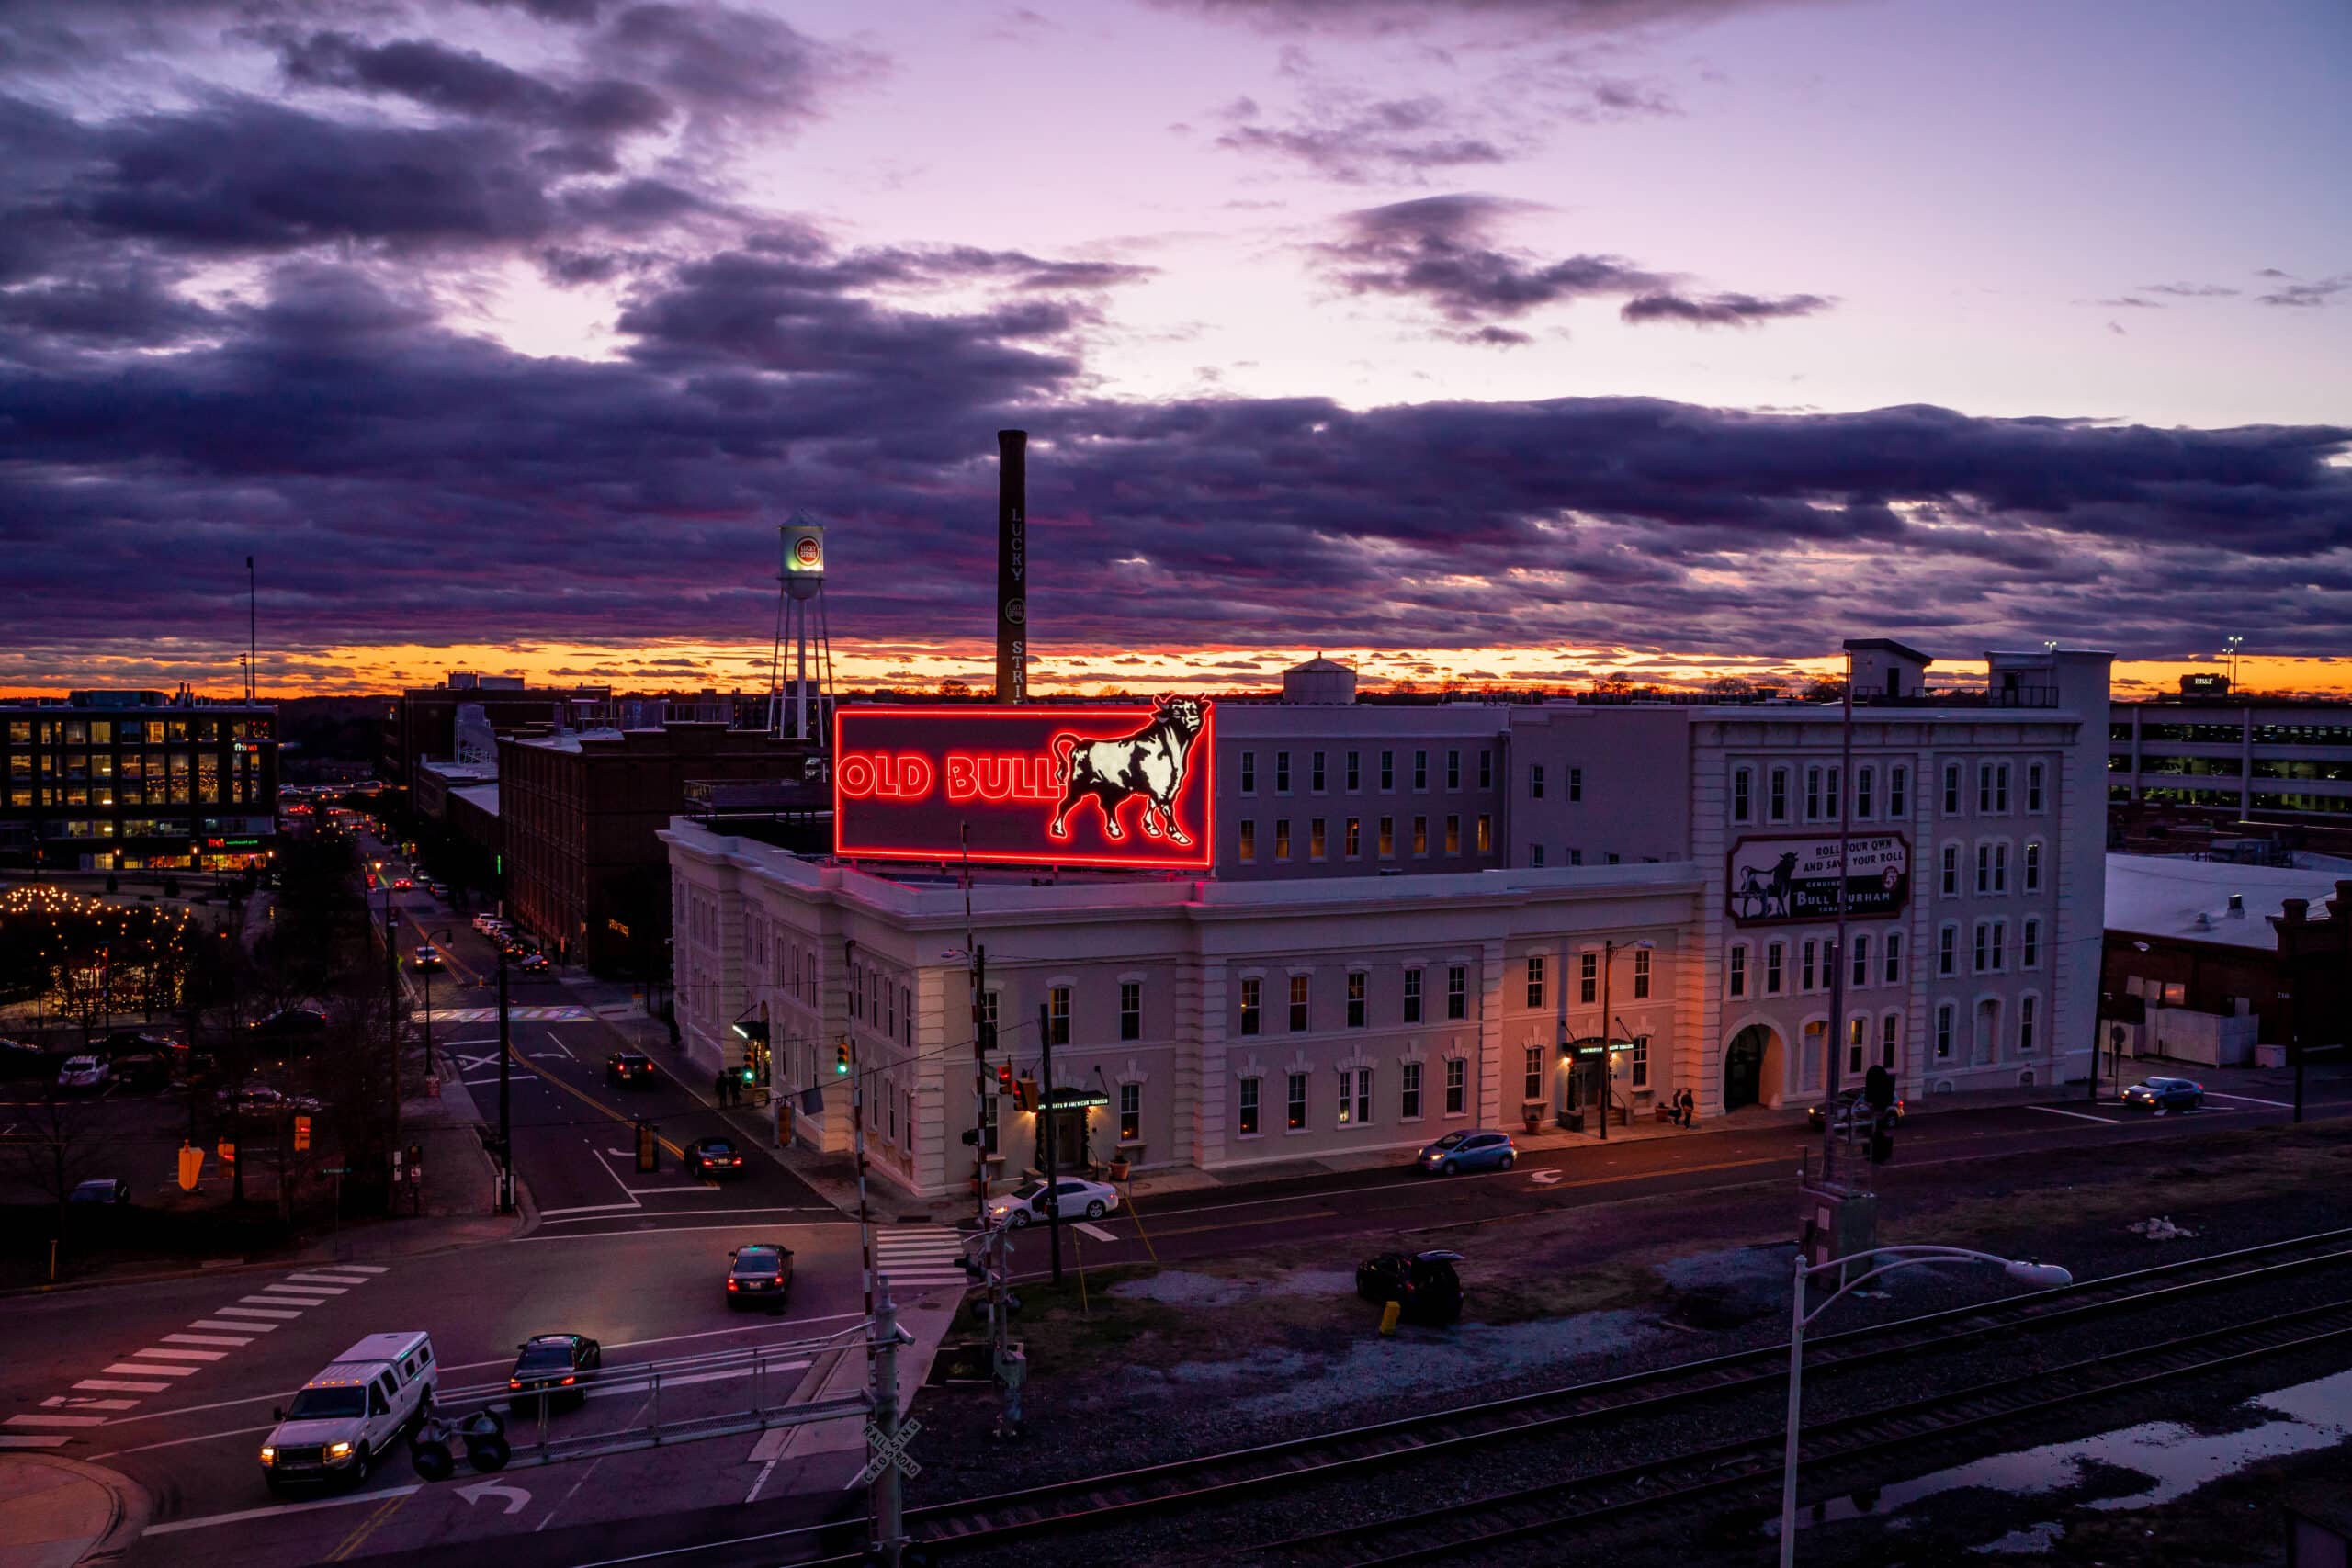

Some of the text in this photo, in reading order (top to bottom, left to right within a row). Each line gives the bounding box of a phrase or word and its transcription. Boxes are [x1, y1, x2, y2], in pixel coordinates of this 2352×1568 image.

[1011, 507, 1023, 581] LUCKY
[837, 756, 1060, 798] OLD BULL
[1804, 852, 1903, 872] AND SAV YOUR ROLL
[1815, 845, 1840, 856] ROLL
[1871, 839, 1892, 851] OWN
[864, 1421, 918, 1481] CROSSING
[865, 1426, 918, 1475] RAILROAD
